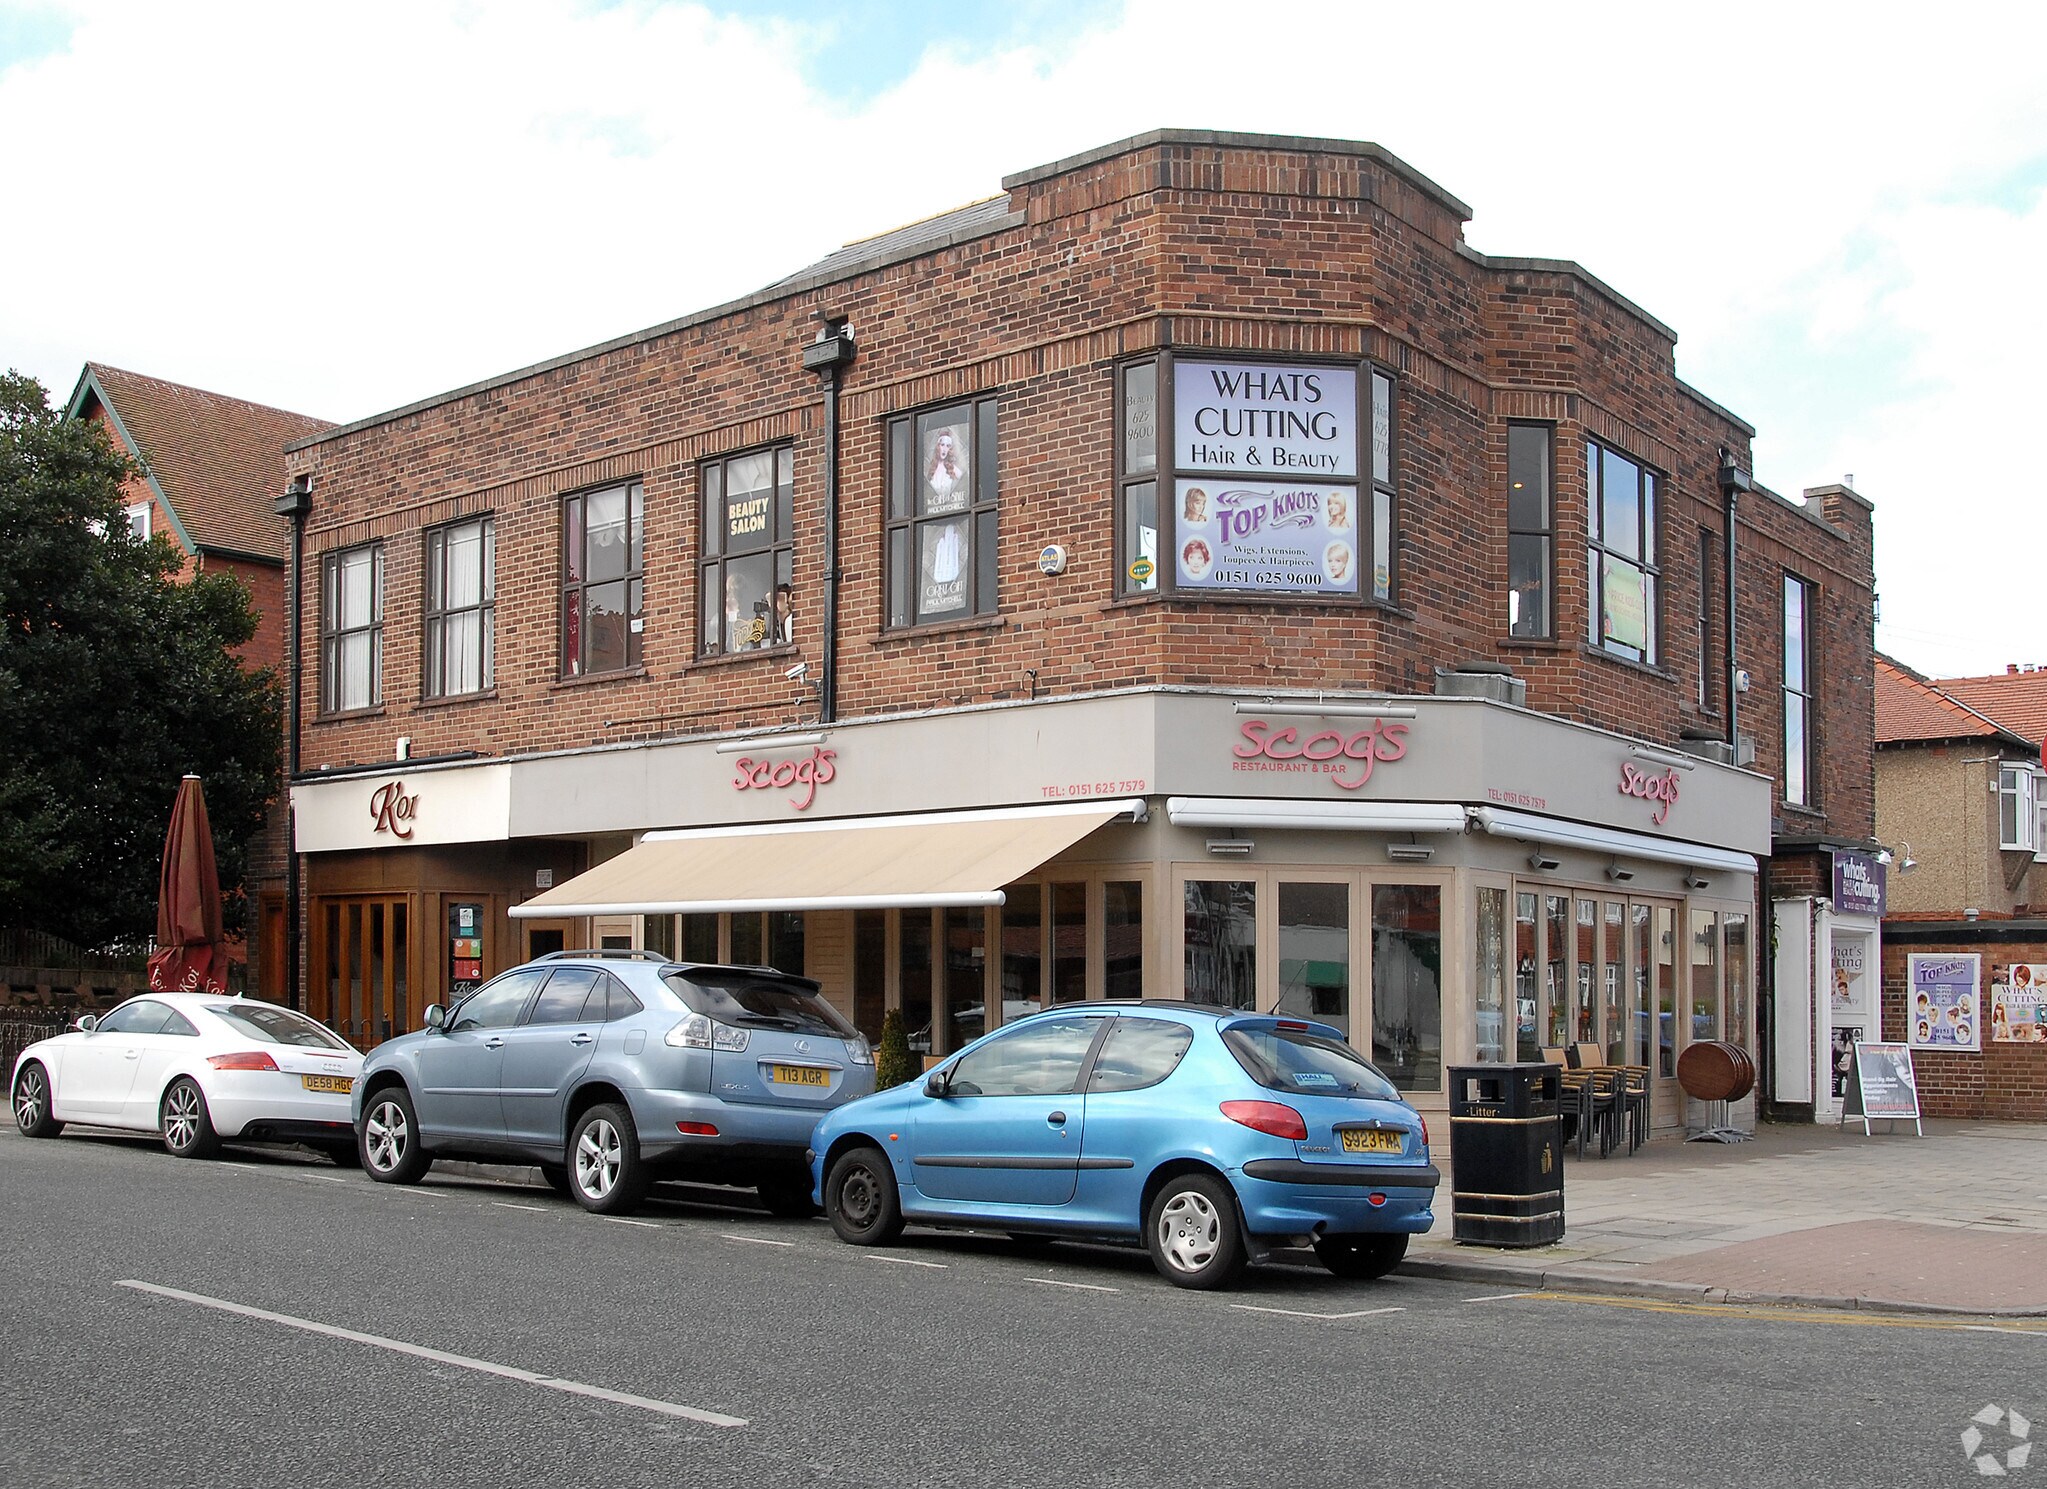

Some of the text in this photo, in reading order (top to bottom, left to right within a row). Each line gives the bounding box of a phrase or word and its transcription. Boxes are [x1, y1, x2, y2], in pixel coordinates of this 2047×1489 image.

[1210, 370, 1323, 403] WHATS
[1132, 410, 1150, 424] 625
[1194, 407, 1338, 441] CUTTING
[1128, 425, 1154, 440] 9600
[1375, 420, 1388, 437] 625
[1246, 445, 1262, 466] &
[729, 497, 769, 520] BEAUTY
[1215, 490, 1320, 544] TOP KNOTS
[731, 514, 766, 536] SALON
[1223, 556, 1315, 567] Toupees & Hairpieces
[1215, 570, 1322, 586] 0151 625 9600
[1231, 717, 1409, 790] Scog's
[1232, 761, 1346, 773] RESTAURANT & BAR
[731, 745, 837, 811] Scog's
[1042, 780, 1146, 797] TEL: 0151 625 7579
[1488, 788, 1546, 808] TEL: 0151 625 7579
[1618, 763, 1680, 825] Scog's
[370, 781, 420, 840] Koi
[179, 966, 200, 993] Koi
[1920, 961, 1967, 982] TOP KNOTS
[2002, 986, 2043, 994] WHAT'S
[307, 1076, 332, 1089] DE58
[780, 1068, 822, 1084] T13 AGR
[1470, 1106, 1496, 1117] Litter
[1343, 1131, 1378, 1148] S923
